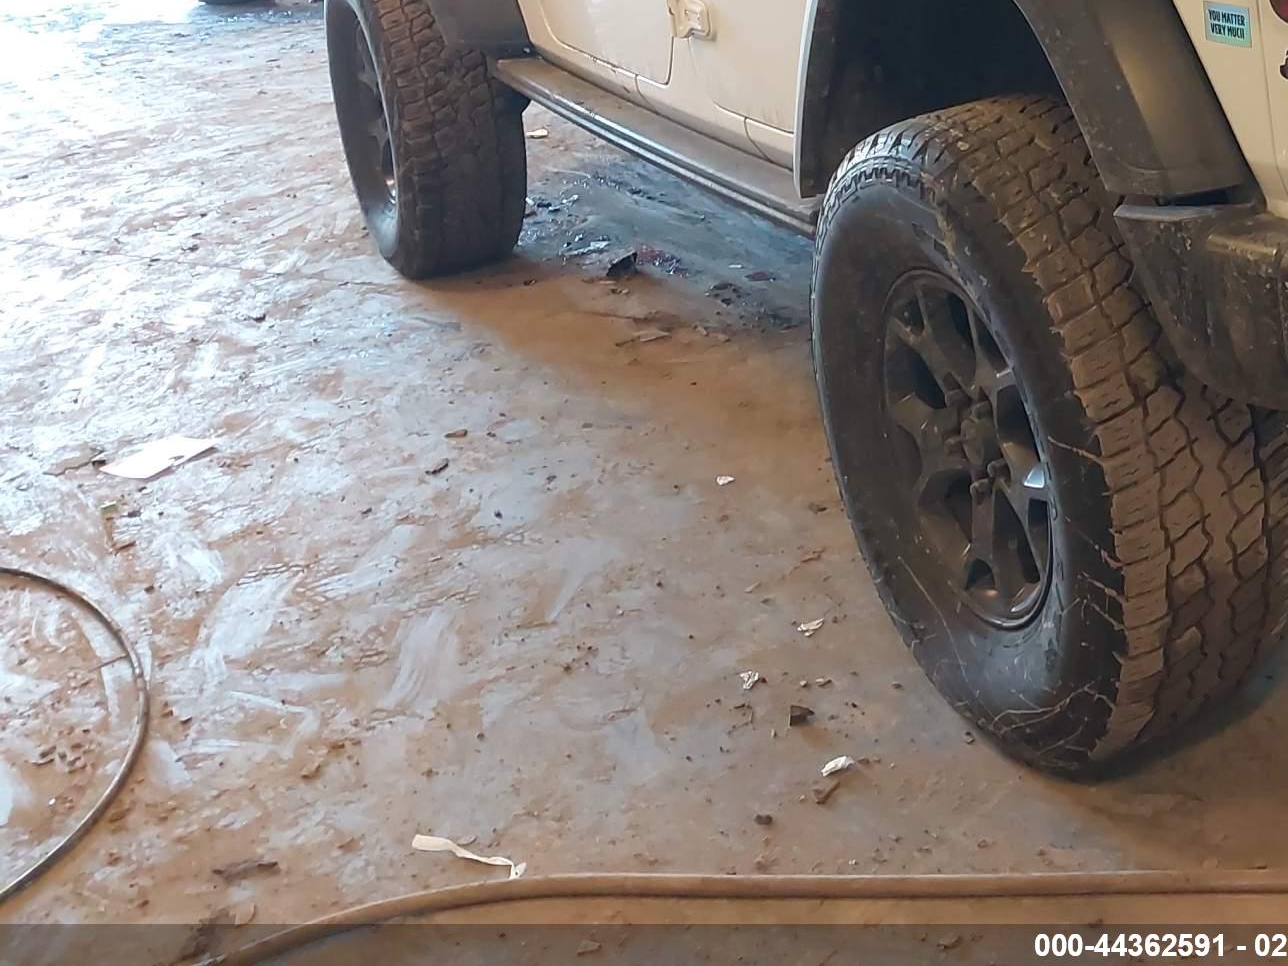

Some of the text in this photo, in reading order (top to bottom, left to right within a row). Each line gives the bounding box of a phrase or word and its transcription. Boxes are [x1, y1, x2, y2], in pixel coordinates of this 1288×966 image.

[1208, 8, 1246, 27] YOU MATTER
[1210, 22, 1245, 40] VERY MUCH
